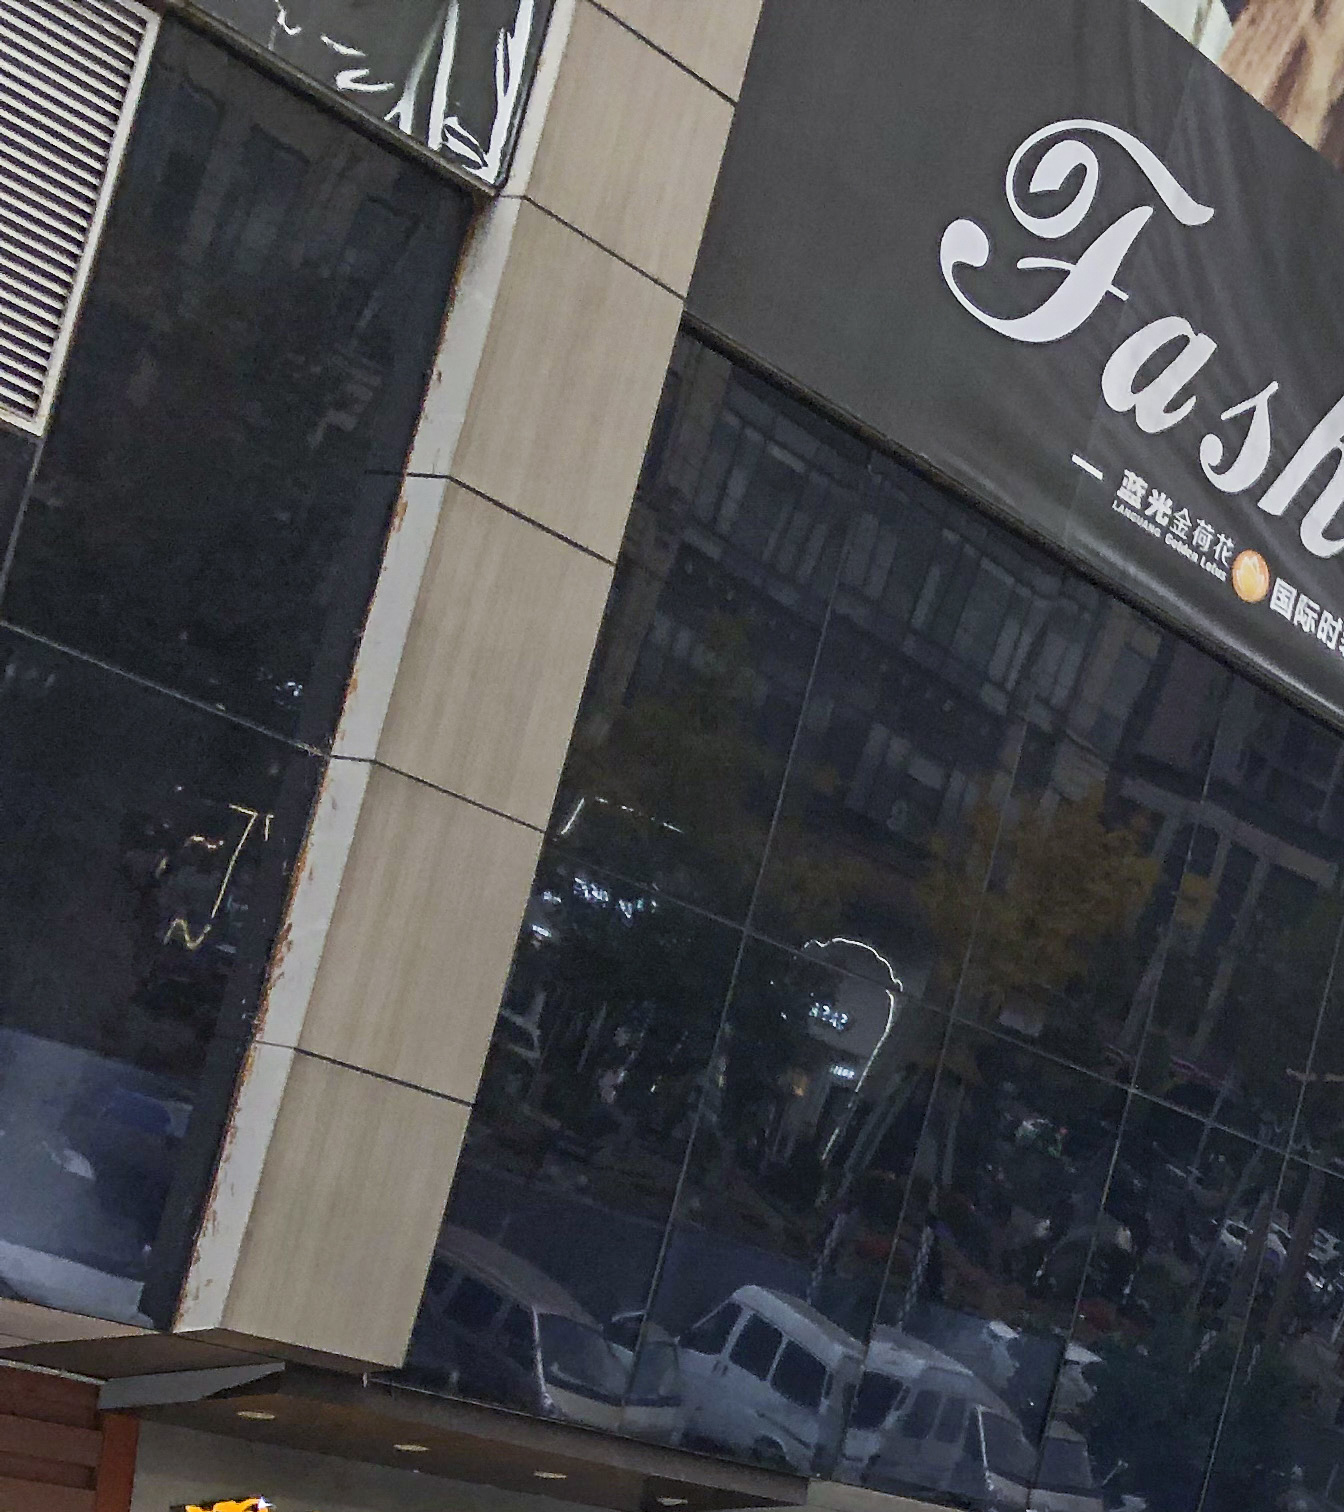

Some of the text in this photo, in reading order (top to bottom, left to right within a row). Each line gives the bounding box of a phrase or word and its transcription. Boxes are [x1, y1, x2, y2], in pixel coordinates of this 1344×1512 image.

[1116, 469, 1236, 569] 蓝光金荷花
[1199, 556, 1228, 583] Lotus
